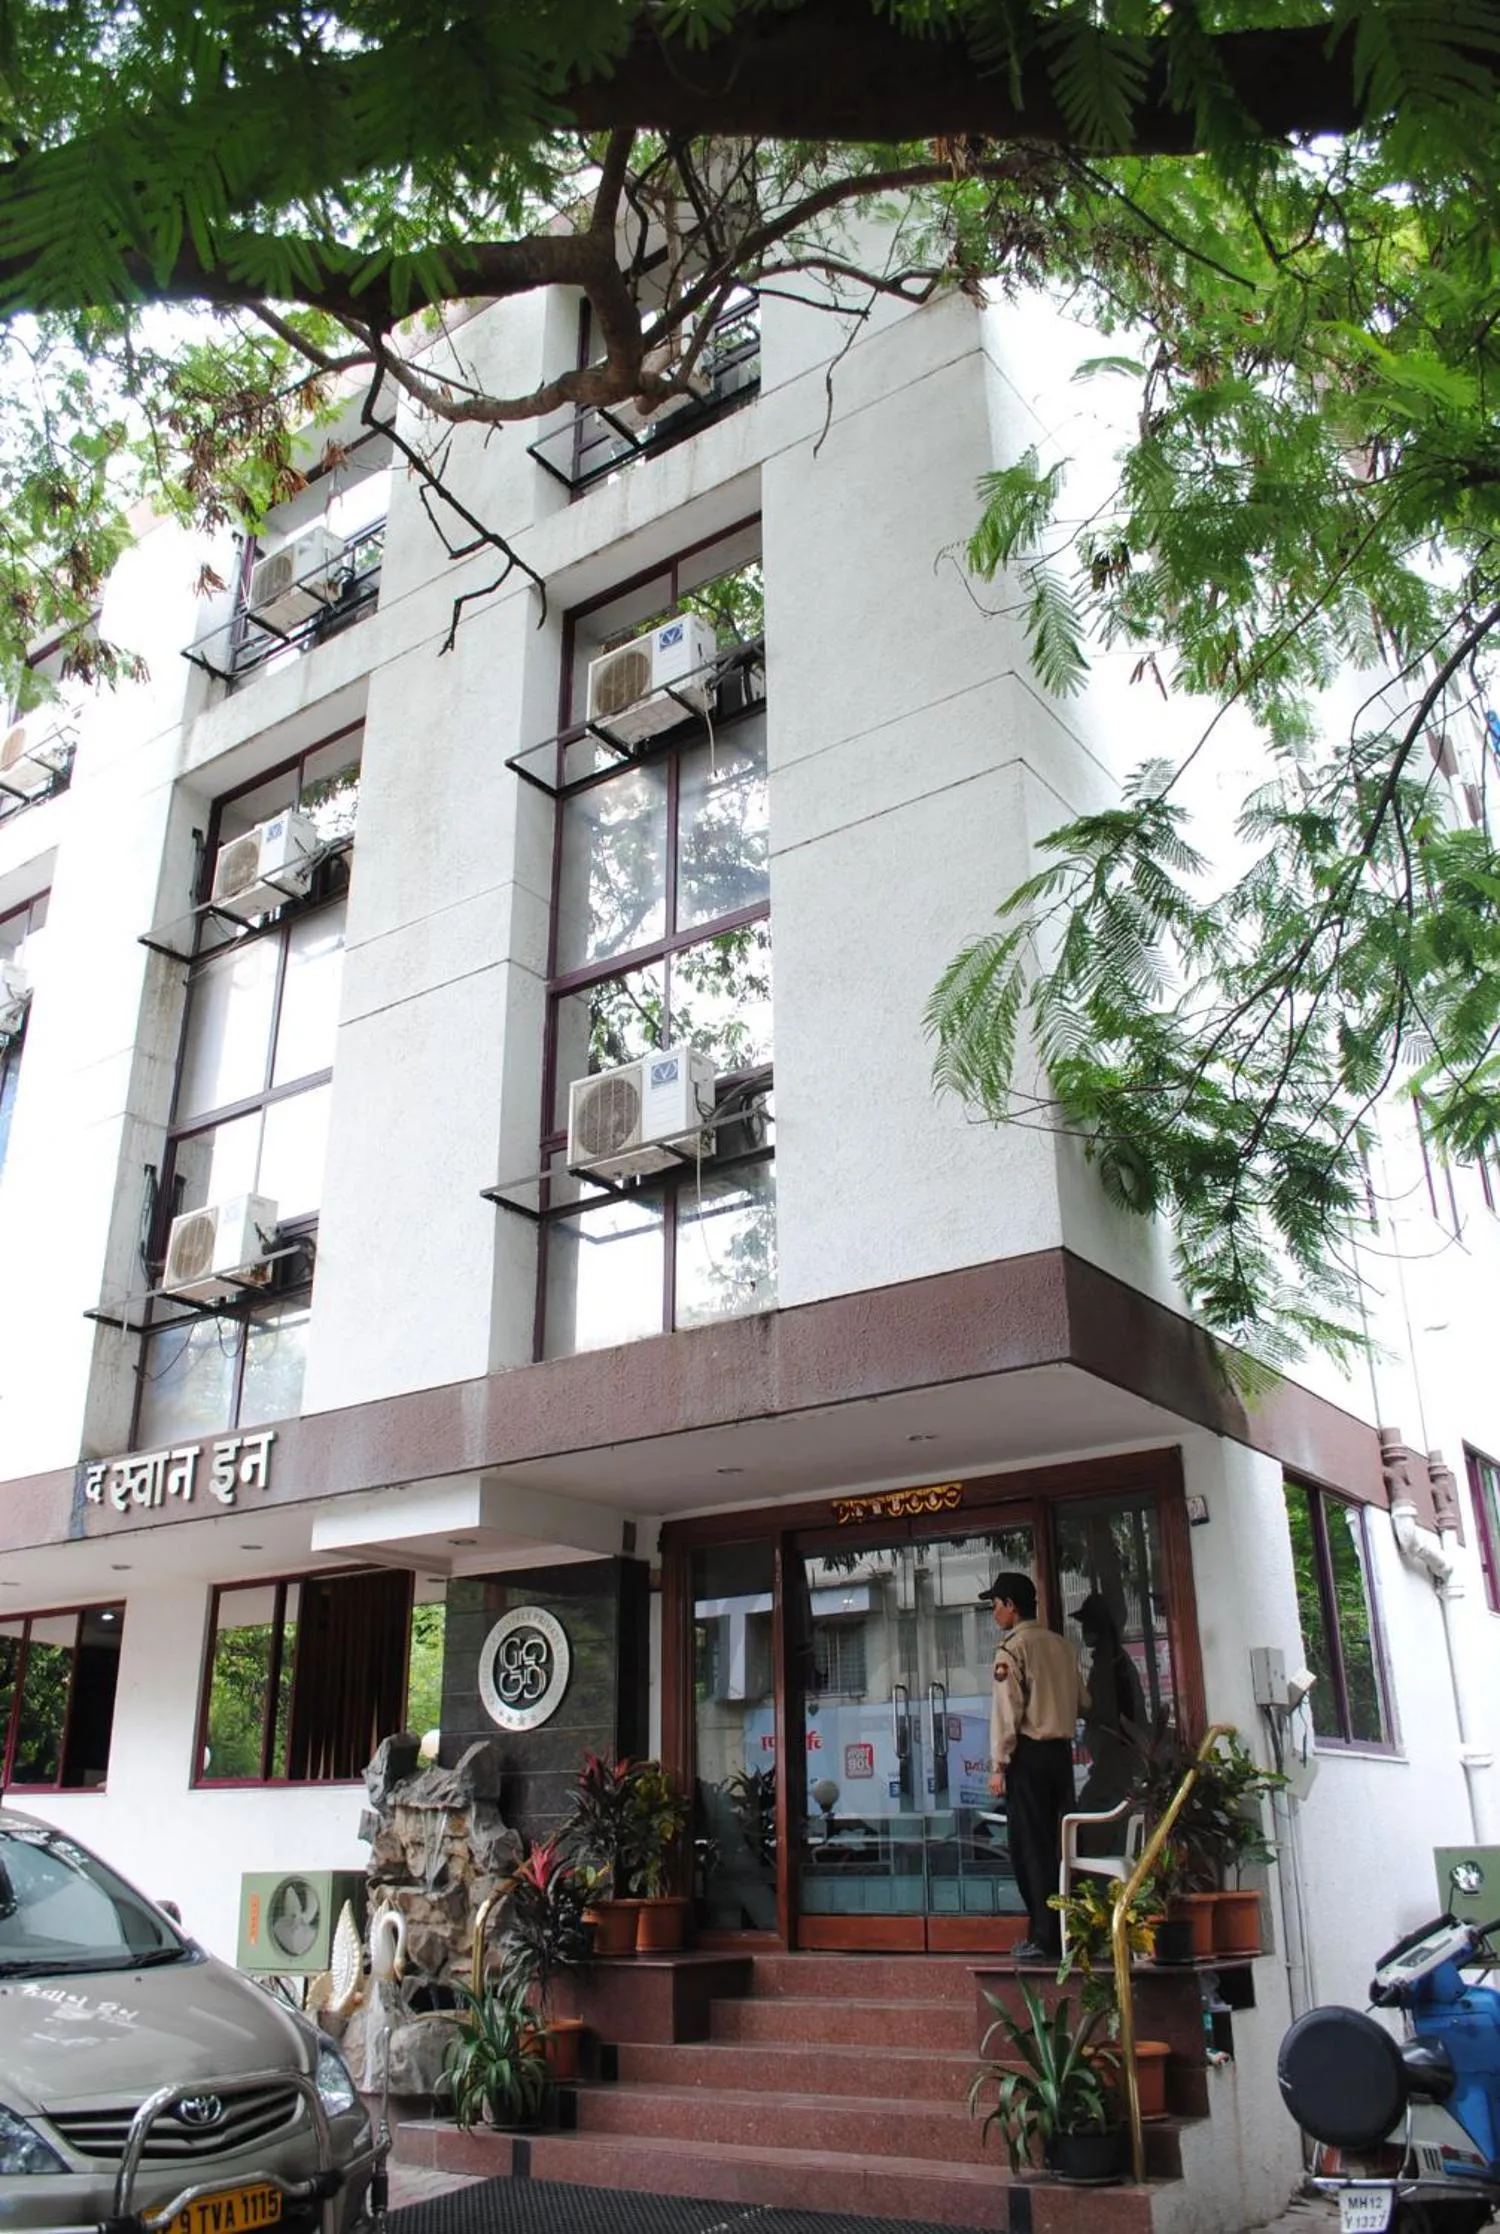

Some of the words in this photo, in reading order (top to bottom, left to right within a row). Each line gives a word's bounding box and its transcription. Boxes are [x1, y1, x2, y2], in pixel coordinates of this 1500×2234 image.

[85, 1464, 106, 1503] द
[110, 1445, 202, 1512] स्वान
[209, 1430, 276, 1504] इन
